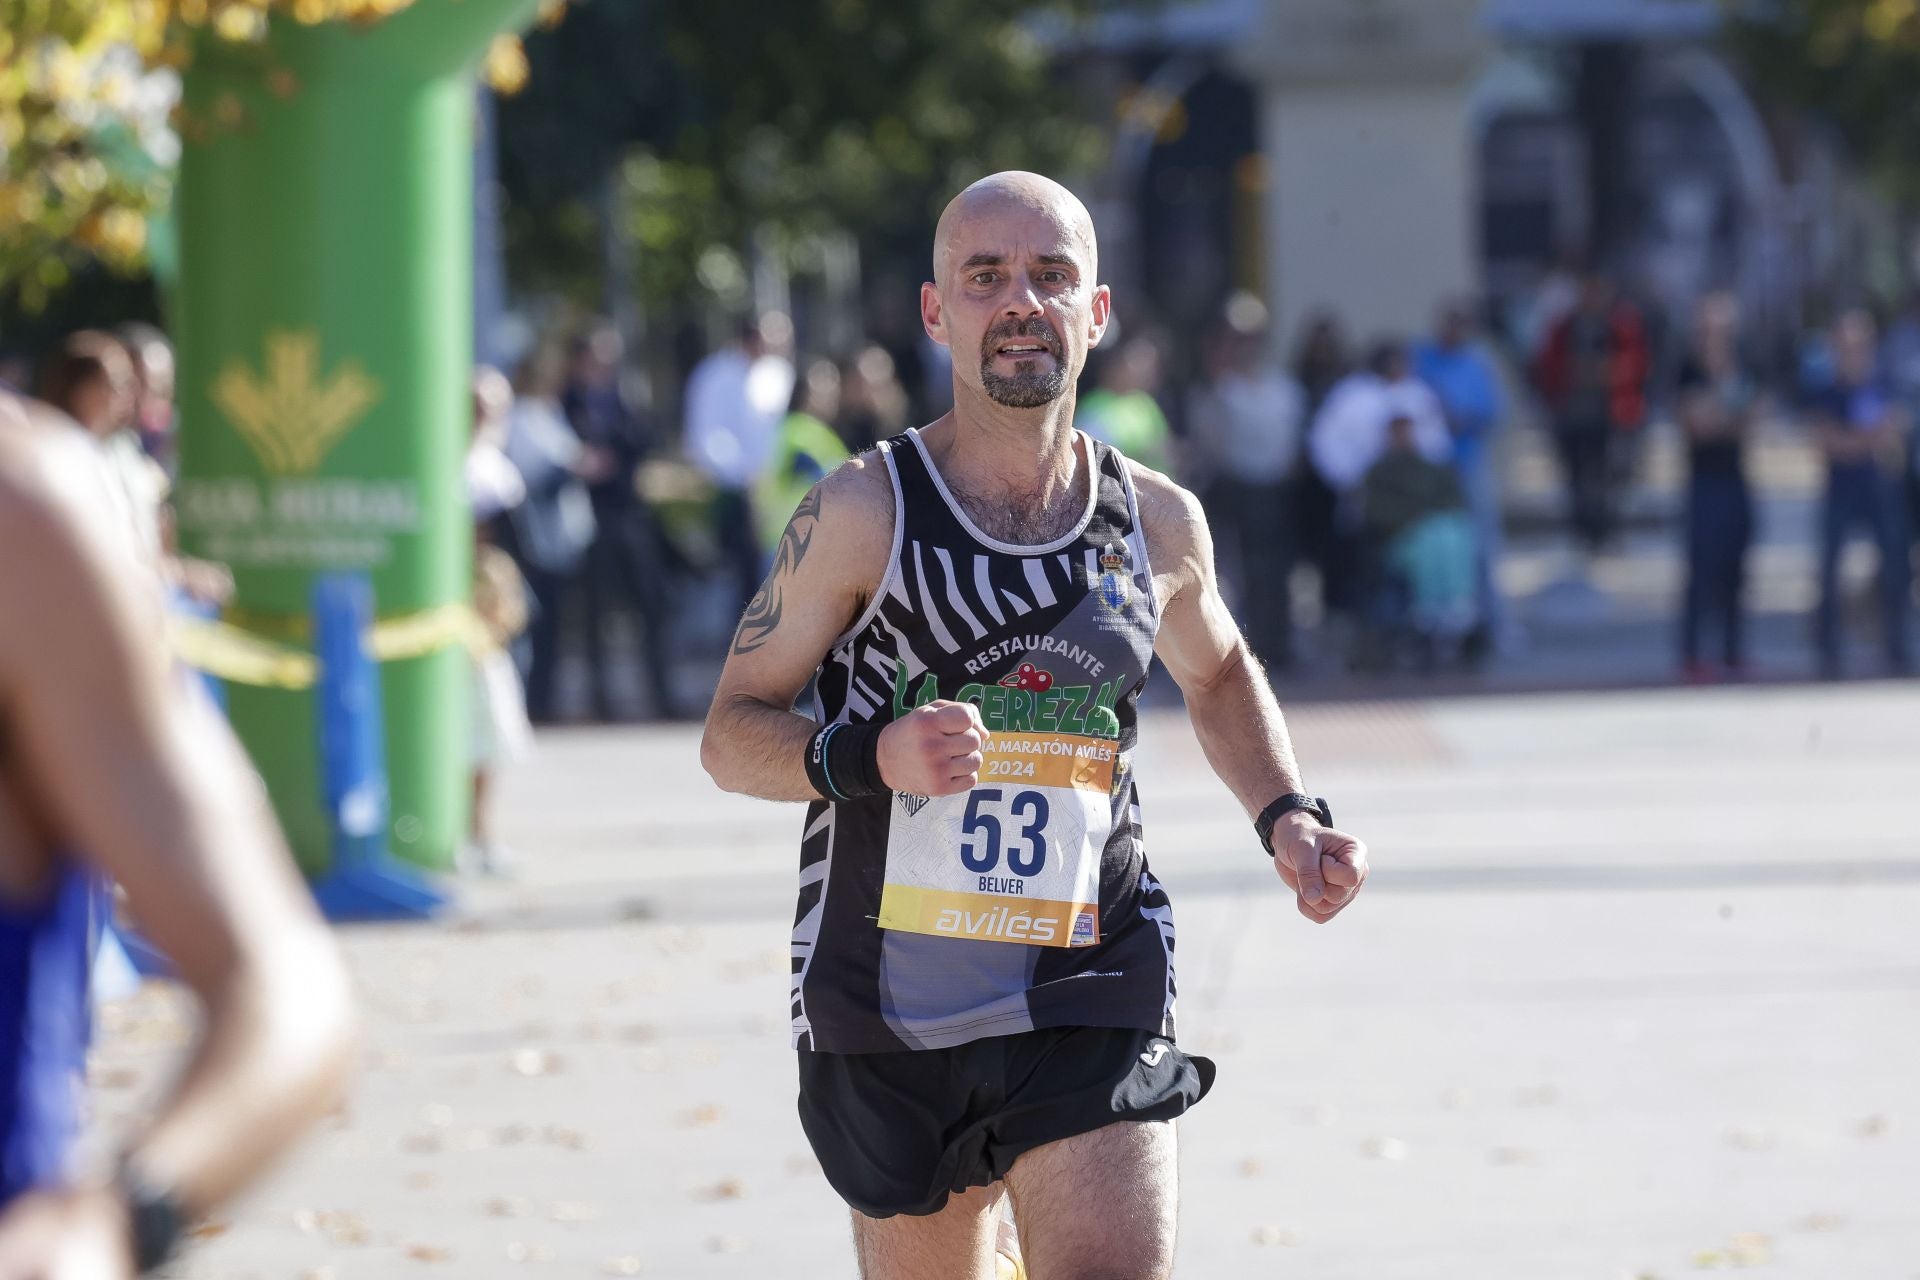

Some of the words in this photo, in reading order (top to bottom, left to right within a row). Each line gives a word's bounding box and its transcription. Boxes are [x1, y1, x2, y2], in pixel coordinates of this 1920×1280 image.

[964, 634, 1105, 678] RESTAURANTE
[999, 738, 1073, 757] MARATÓN
[1074, 743, 1112, 762] AVILÉS
[987, 760, 1035, 777] 2024
[960, 788, 1050, 877] 53
[978, 876, 1024, 895] BELVER
[934, 905, 1058, 941] avilés
